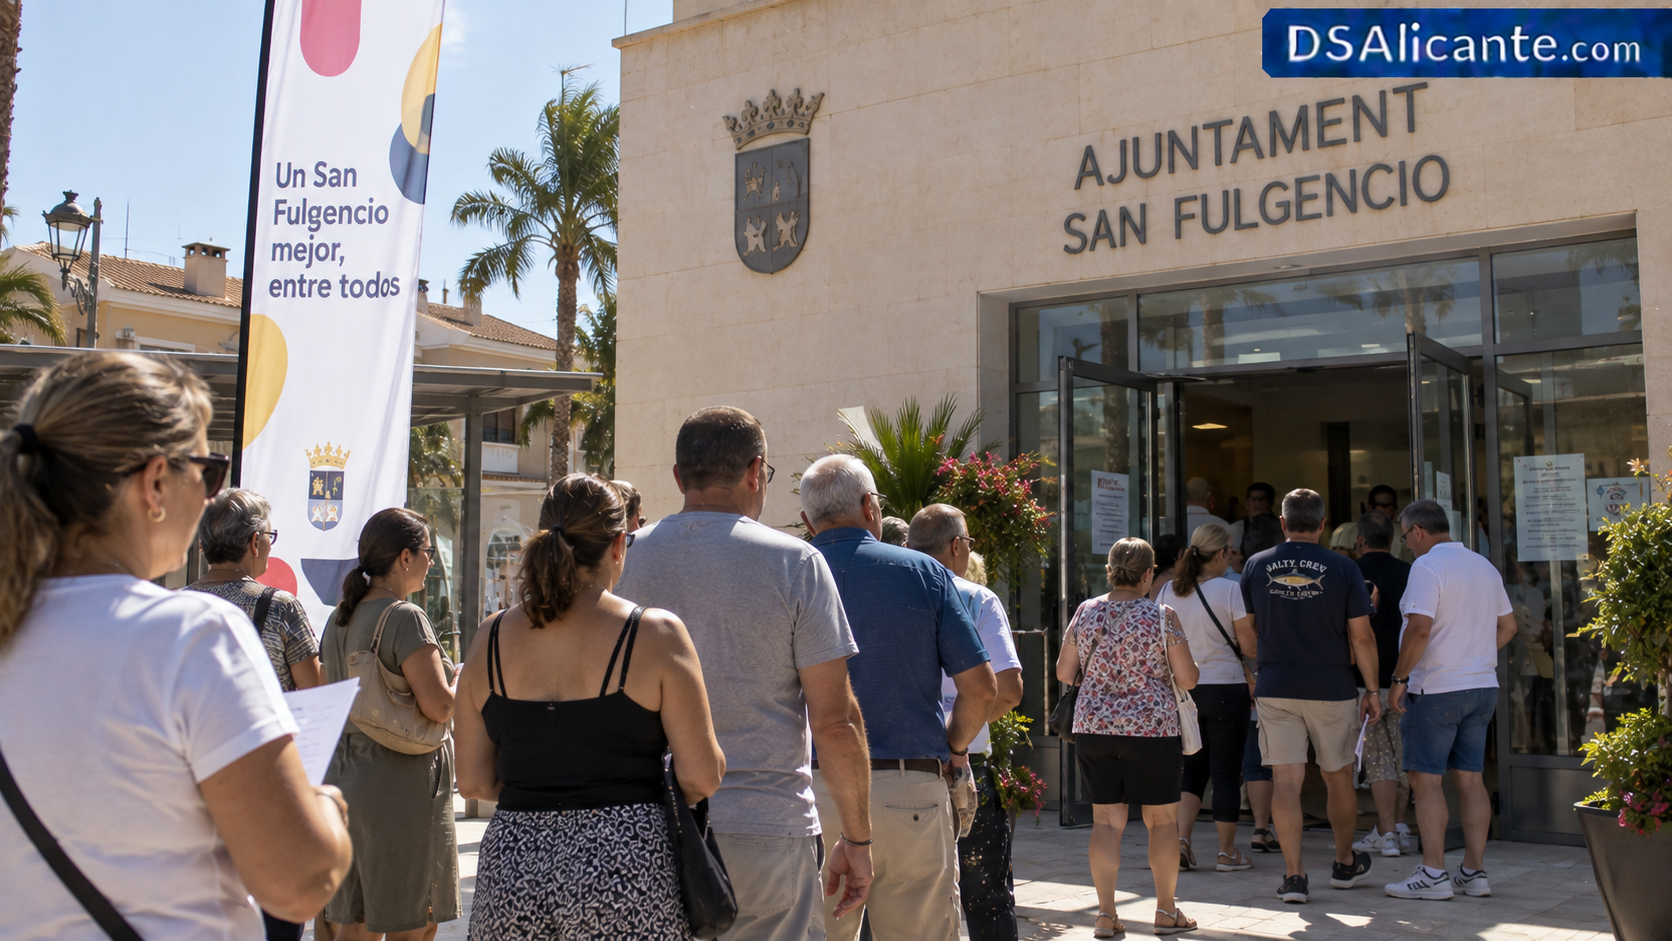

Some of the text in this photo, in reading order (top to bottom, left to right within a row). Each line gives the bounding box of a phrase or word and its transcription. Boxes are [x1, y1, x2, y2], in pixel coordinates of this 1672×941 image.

[1074, 82, 1428, 190] AJUNTAMENT
[276, 161, 357, 188] Un San
[273, 197, 389, 232] Fulgencio
[1063, 154, 1450, 255] SAN FULGENCIO
[271, 234, 345, 269] mejor,
[268, 271, 401, 298] entre todos
